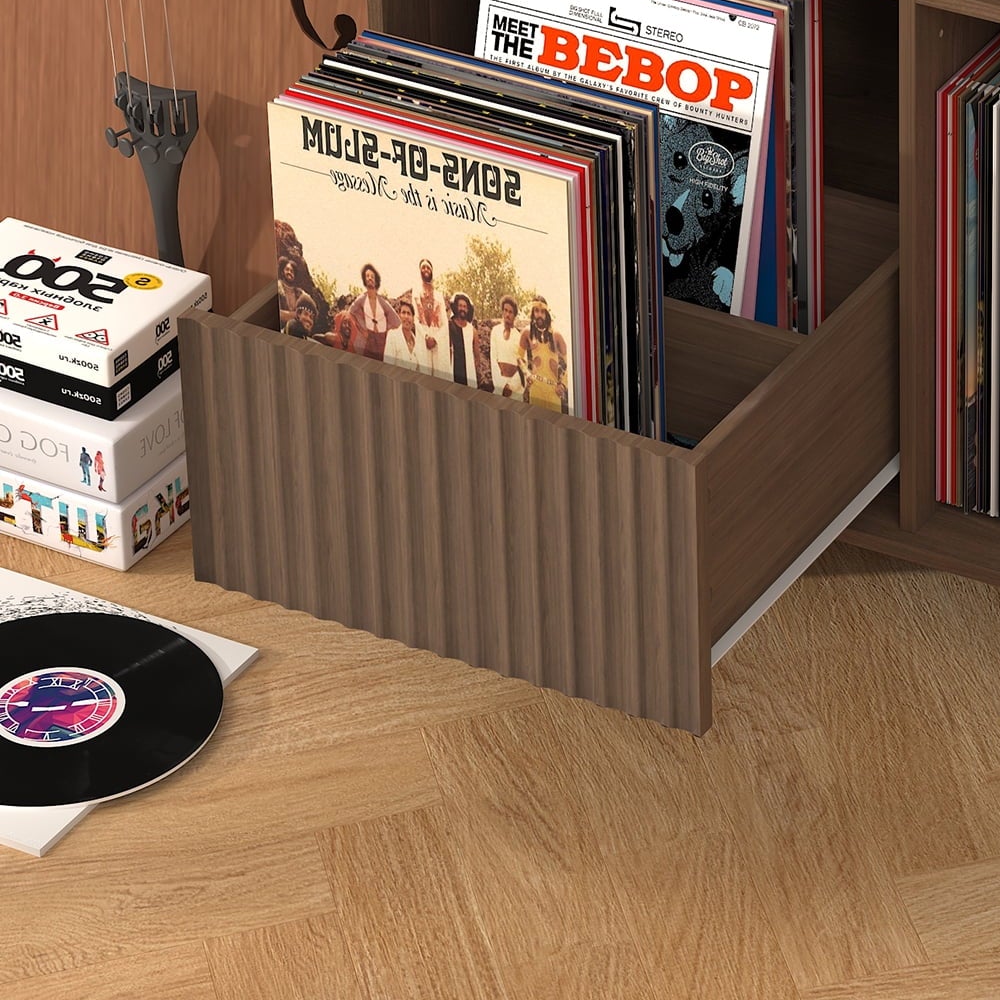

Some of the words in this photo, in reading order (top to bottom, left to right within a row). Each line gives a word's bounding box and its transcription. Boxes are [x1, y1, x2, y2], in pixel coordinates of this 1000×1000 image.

[492, 14, 539, 39] MEET
[645, 25, 684, 43] STEREO
[491, 30, 534, 60] THE
[537, 24, 754, 112] BEBOP
[489, 54, 503, 63] THE
[505, 58, 525, 69] FIRST
[527, 64, 550, 75] ALBUM
[552, 70, 562, 79] BY
[564, 73, 577, 83] THE
[579, 77, 614, 92] GALAXY'S
[615, 86, 649, 101] FAVORITE
[651, 94, 671, 105] CREW
[673, 100, 682, 109] OF
[684, 104, 713, 118] BOUNTY
[715, 111, 749, 126] HUNTERS
